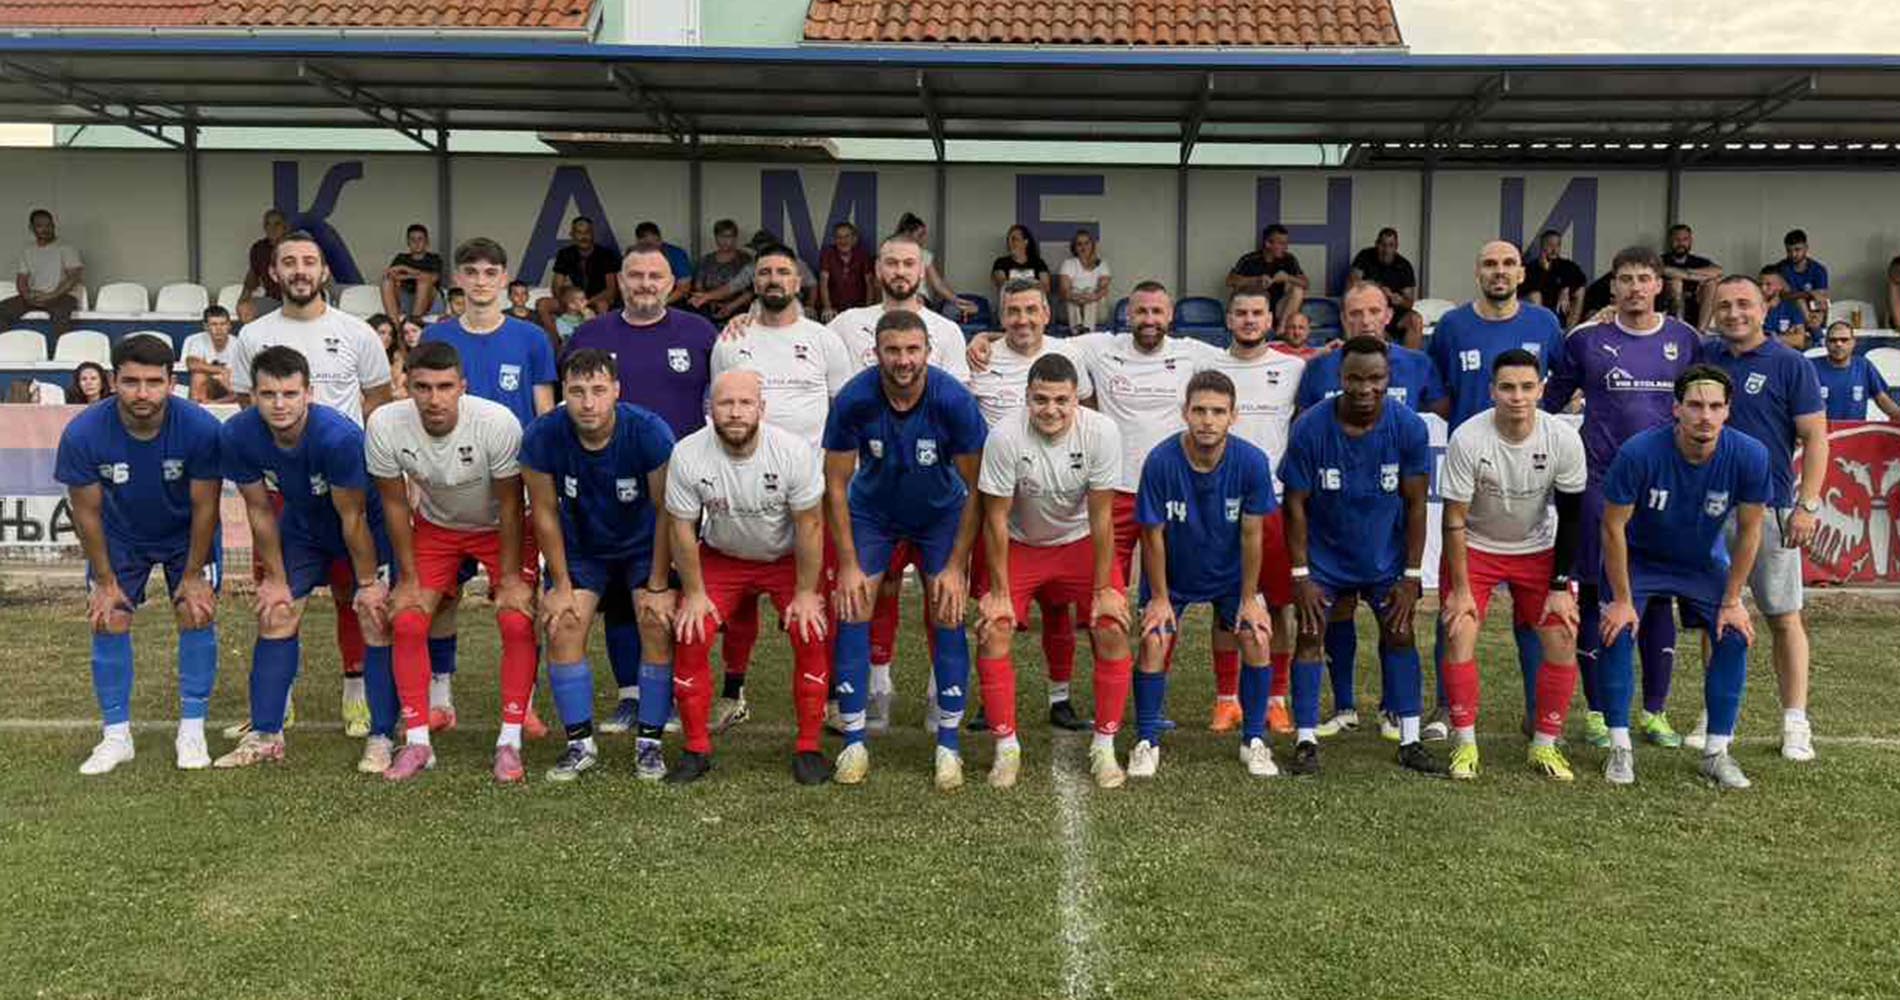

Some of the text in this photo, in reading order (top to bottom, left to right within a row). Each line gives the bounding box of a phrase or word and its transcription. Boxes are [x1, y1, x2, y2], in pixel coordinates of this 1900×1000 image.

[1459, 350, 1481, 372] 19
[1318, 468, 1341, 490] 16
[1647, 488, 1669, 511] 11
[1165, 500, 1187, 522] 14
